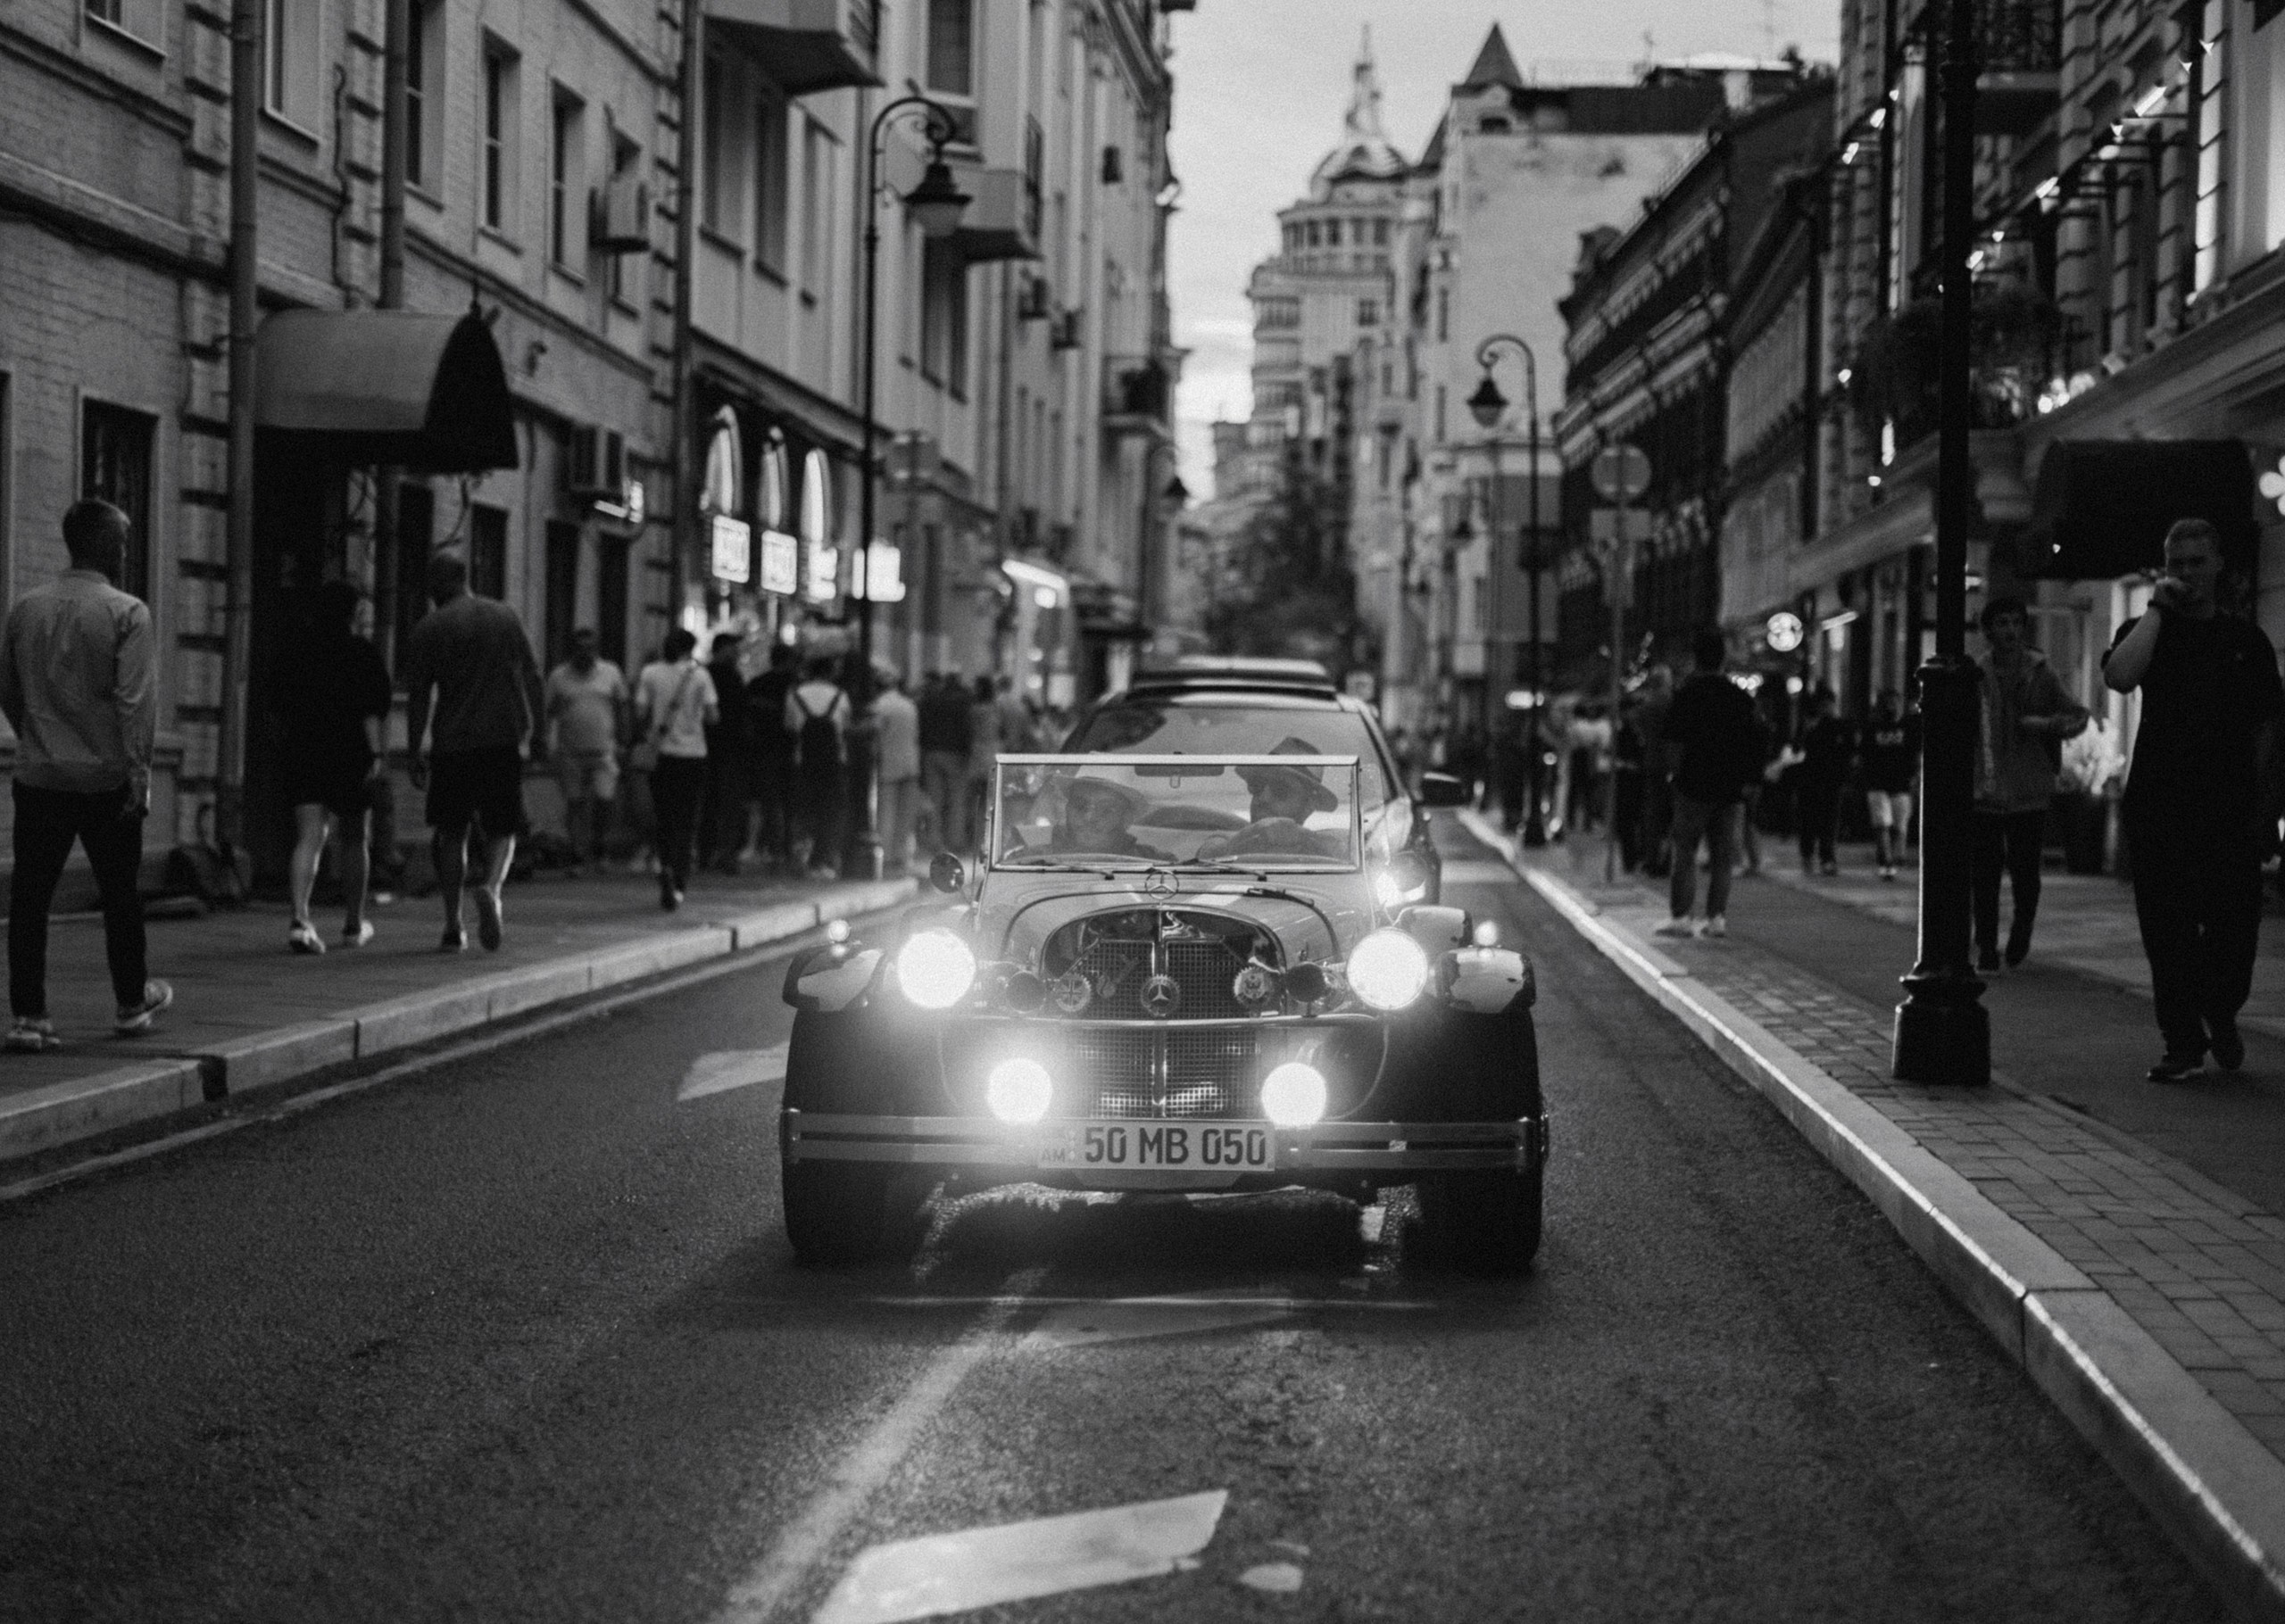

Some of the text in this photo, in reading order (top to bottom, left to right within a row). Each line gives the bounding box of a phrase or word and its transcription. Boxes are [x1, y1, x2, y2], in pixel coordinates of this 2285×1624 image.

[1041, 1148, 1066, 1162] AM
[1084, 1126, 1267, 1165] 50 MB 050
